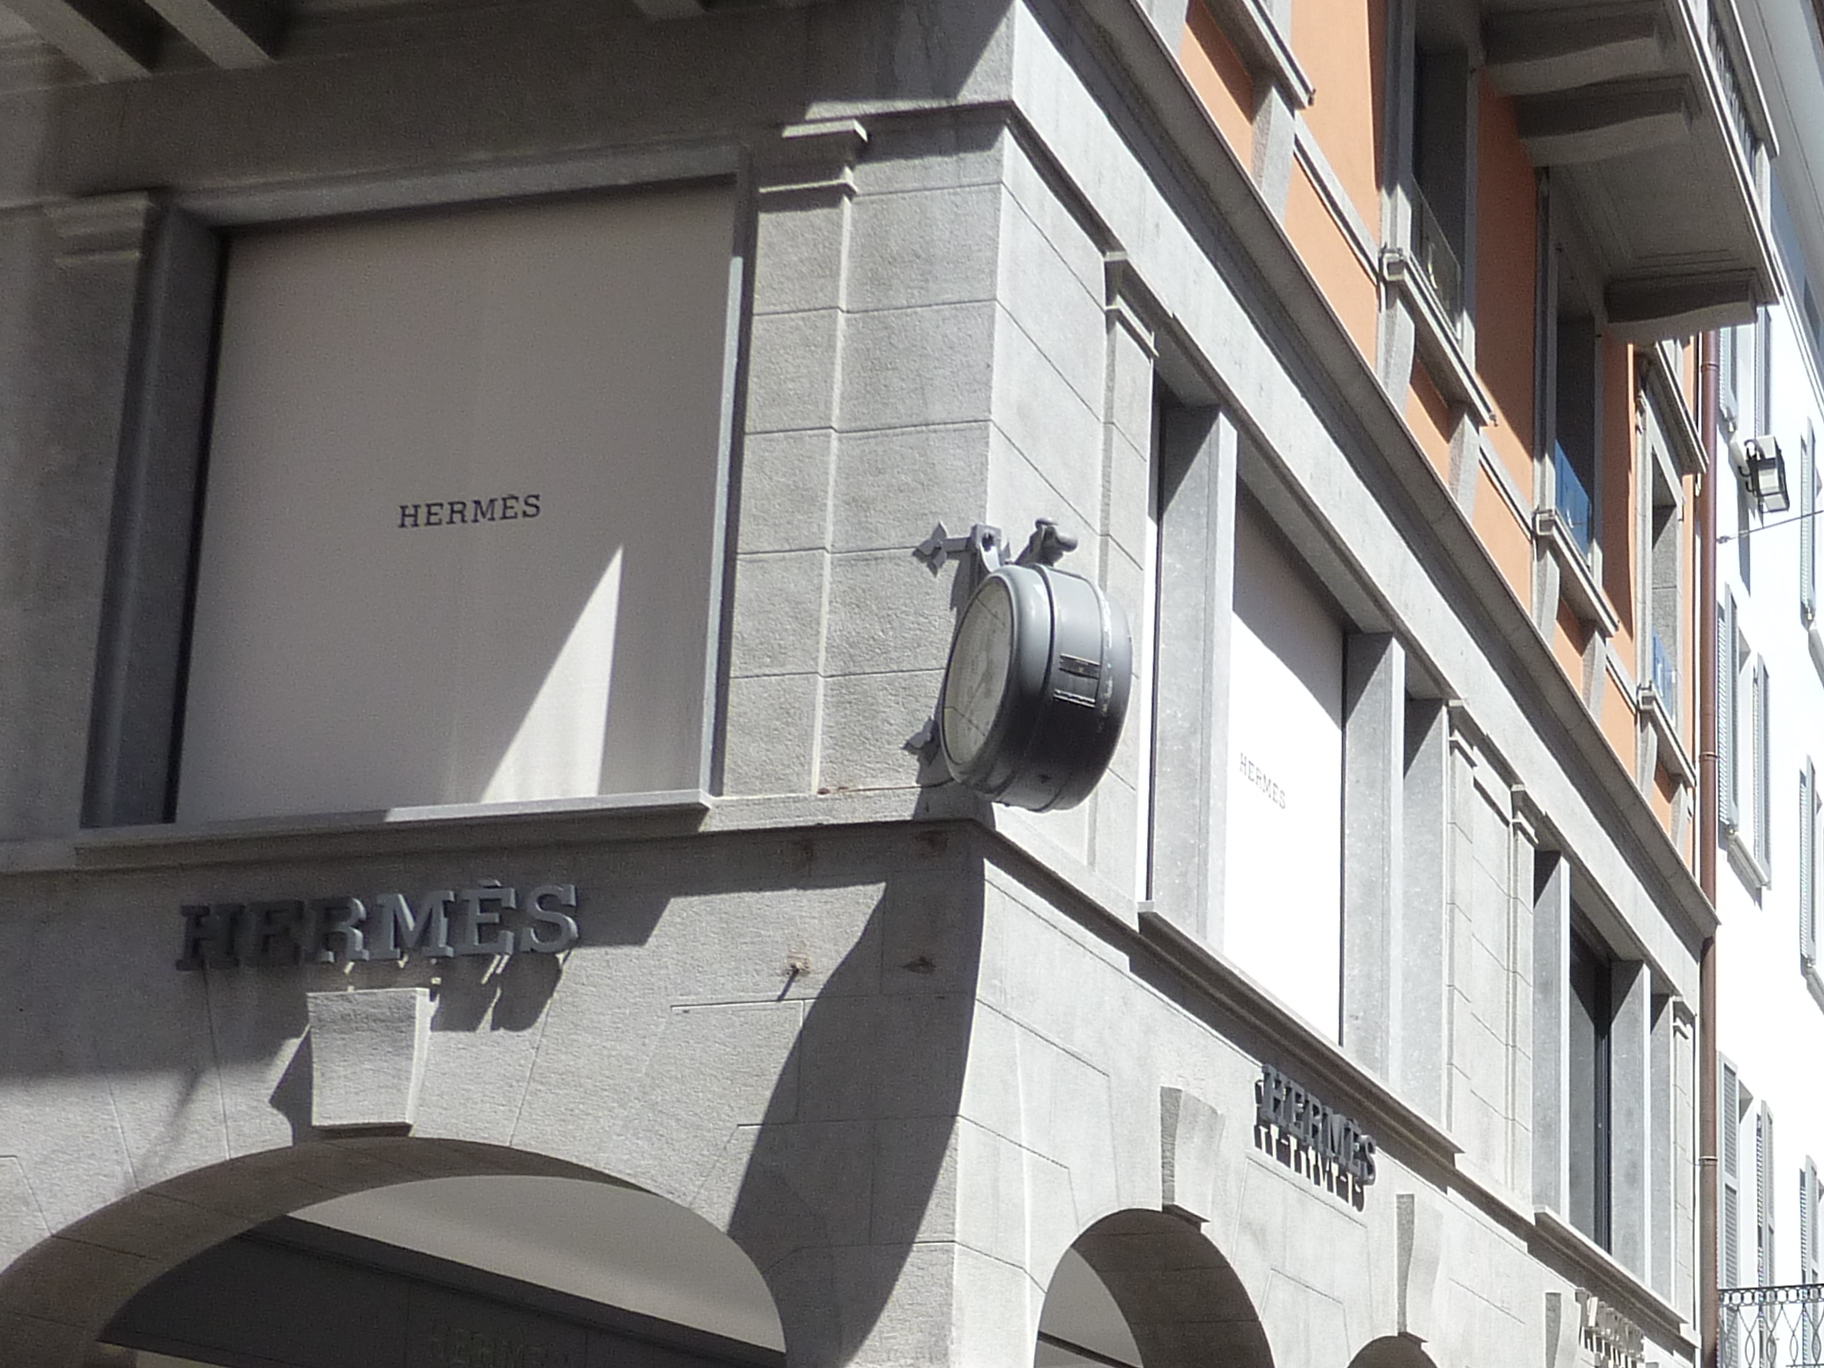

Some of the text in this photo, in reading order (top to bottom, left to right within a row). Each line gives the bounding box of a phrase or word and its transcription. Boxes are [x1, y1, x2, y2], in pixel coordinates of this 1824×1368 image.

[397, 494, 542, 529] HERMÈS
[176, 879, 579, 971] HERMÈS
[1258, 1063, 1376, 1186] HERMÈS
